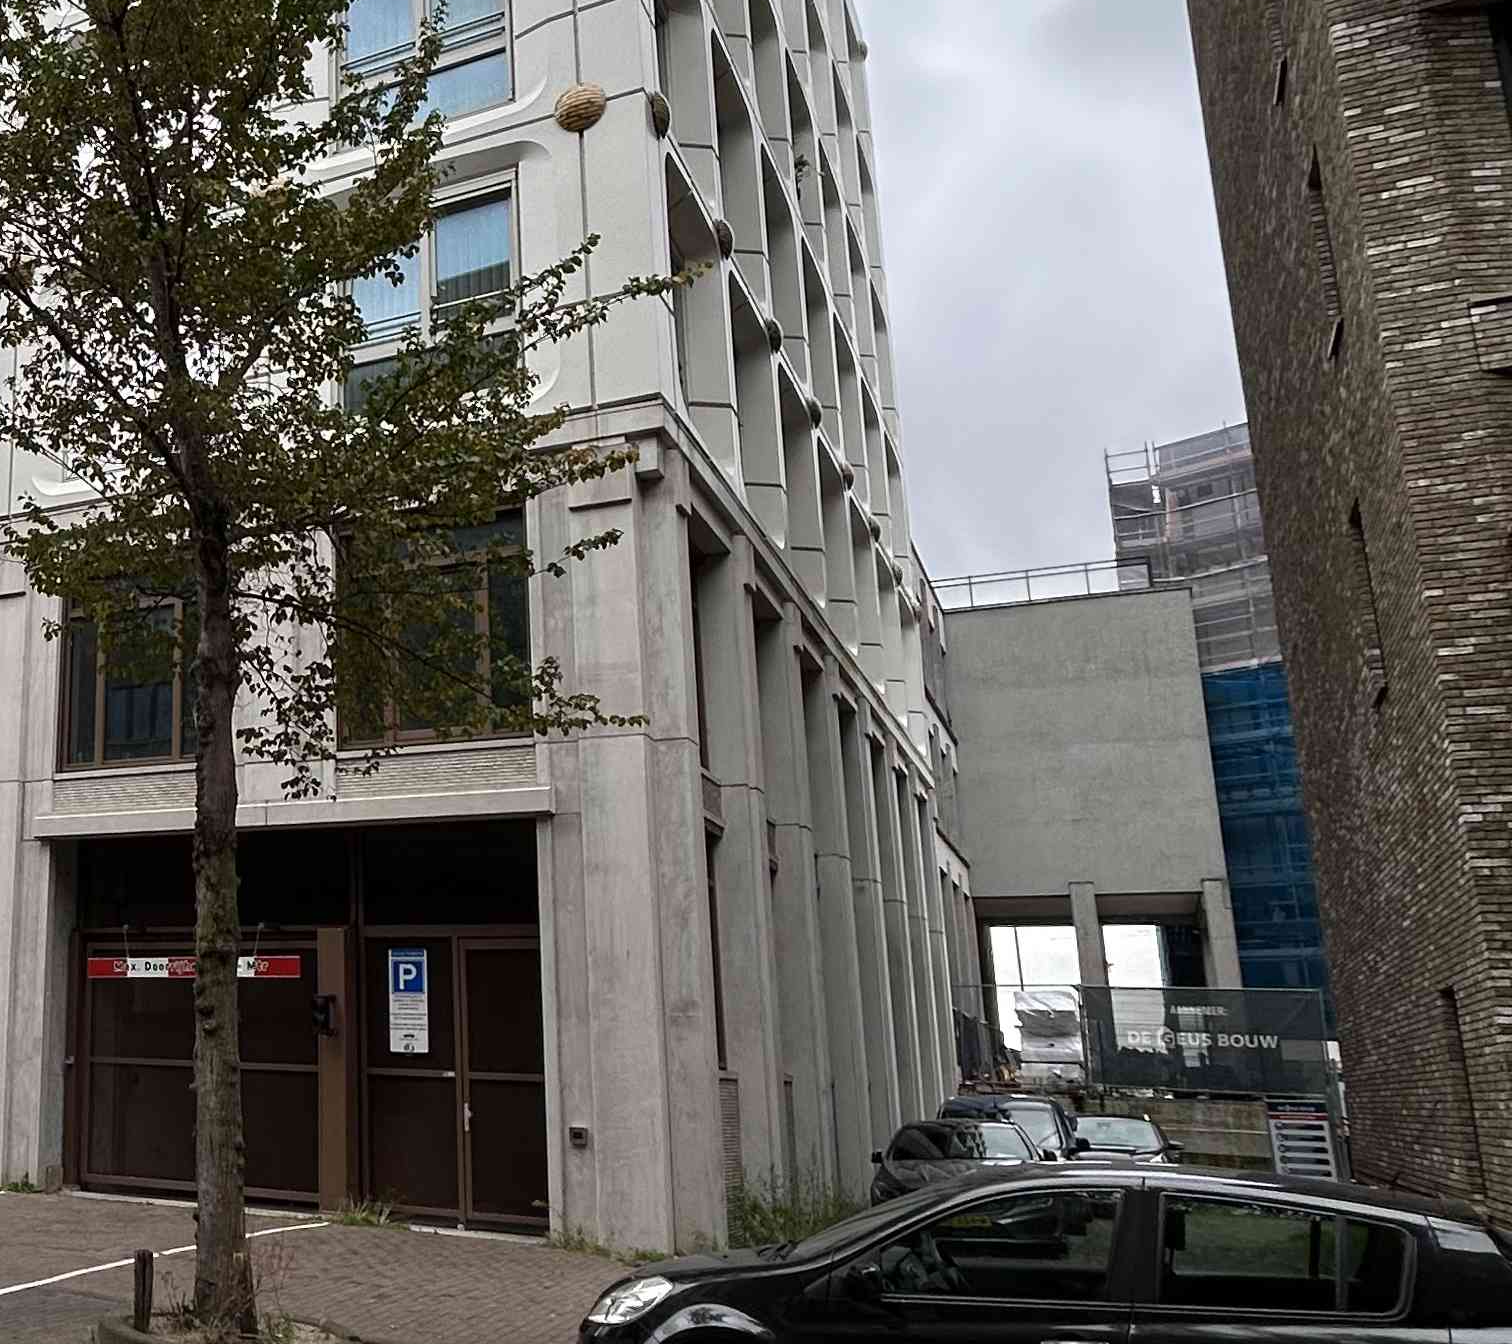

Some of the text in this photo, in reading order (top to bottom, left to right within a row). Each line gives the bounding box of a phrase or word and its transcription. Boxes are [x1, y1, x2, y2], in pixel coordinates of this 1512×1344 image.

[399, 963, 417, 990] P
[1127, 1028, 1279, 1049] DE GEUS BOUW
